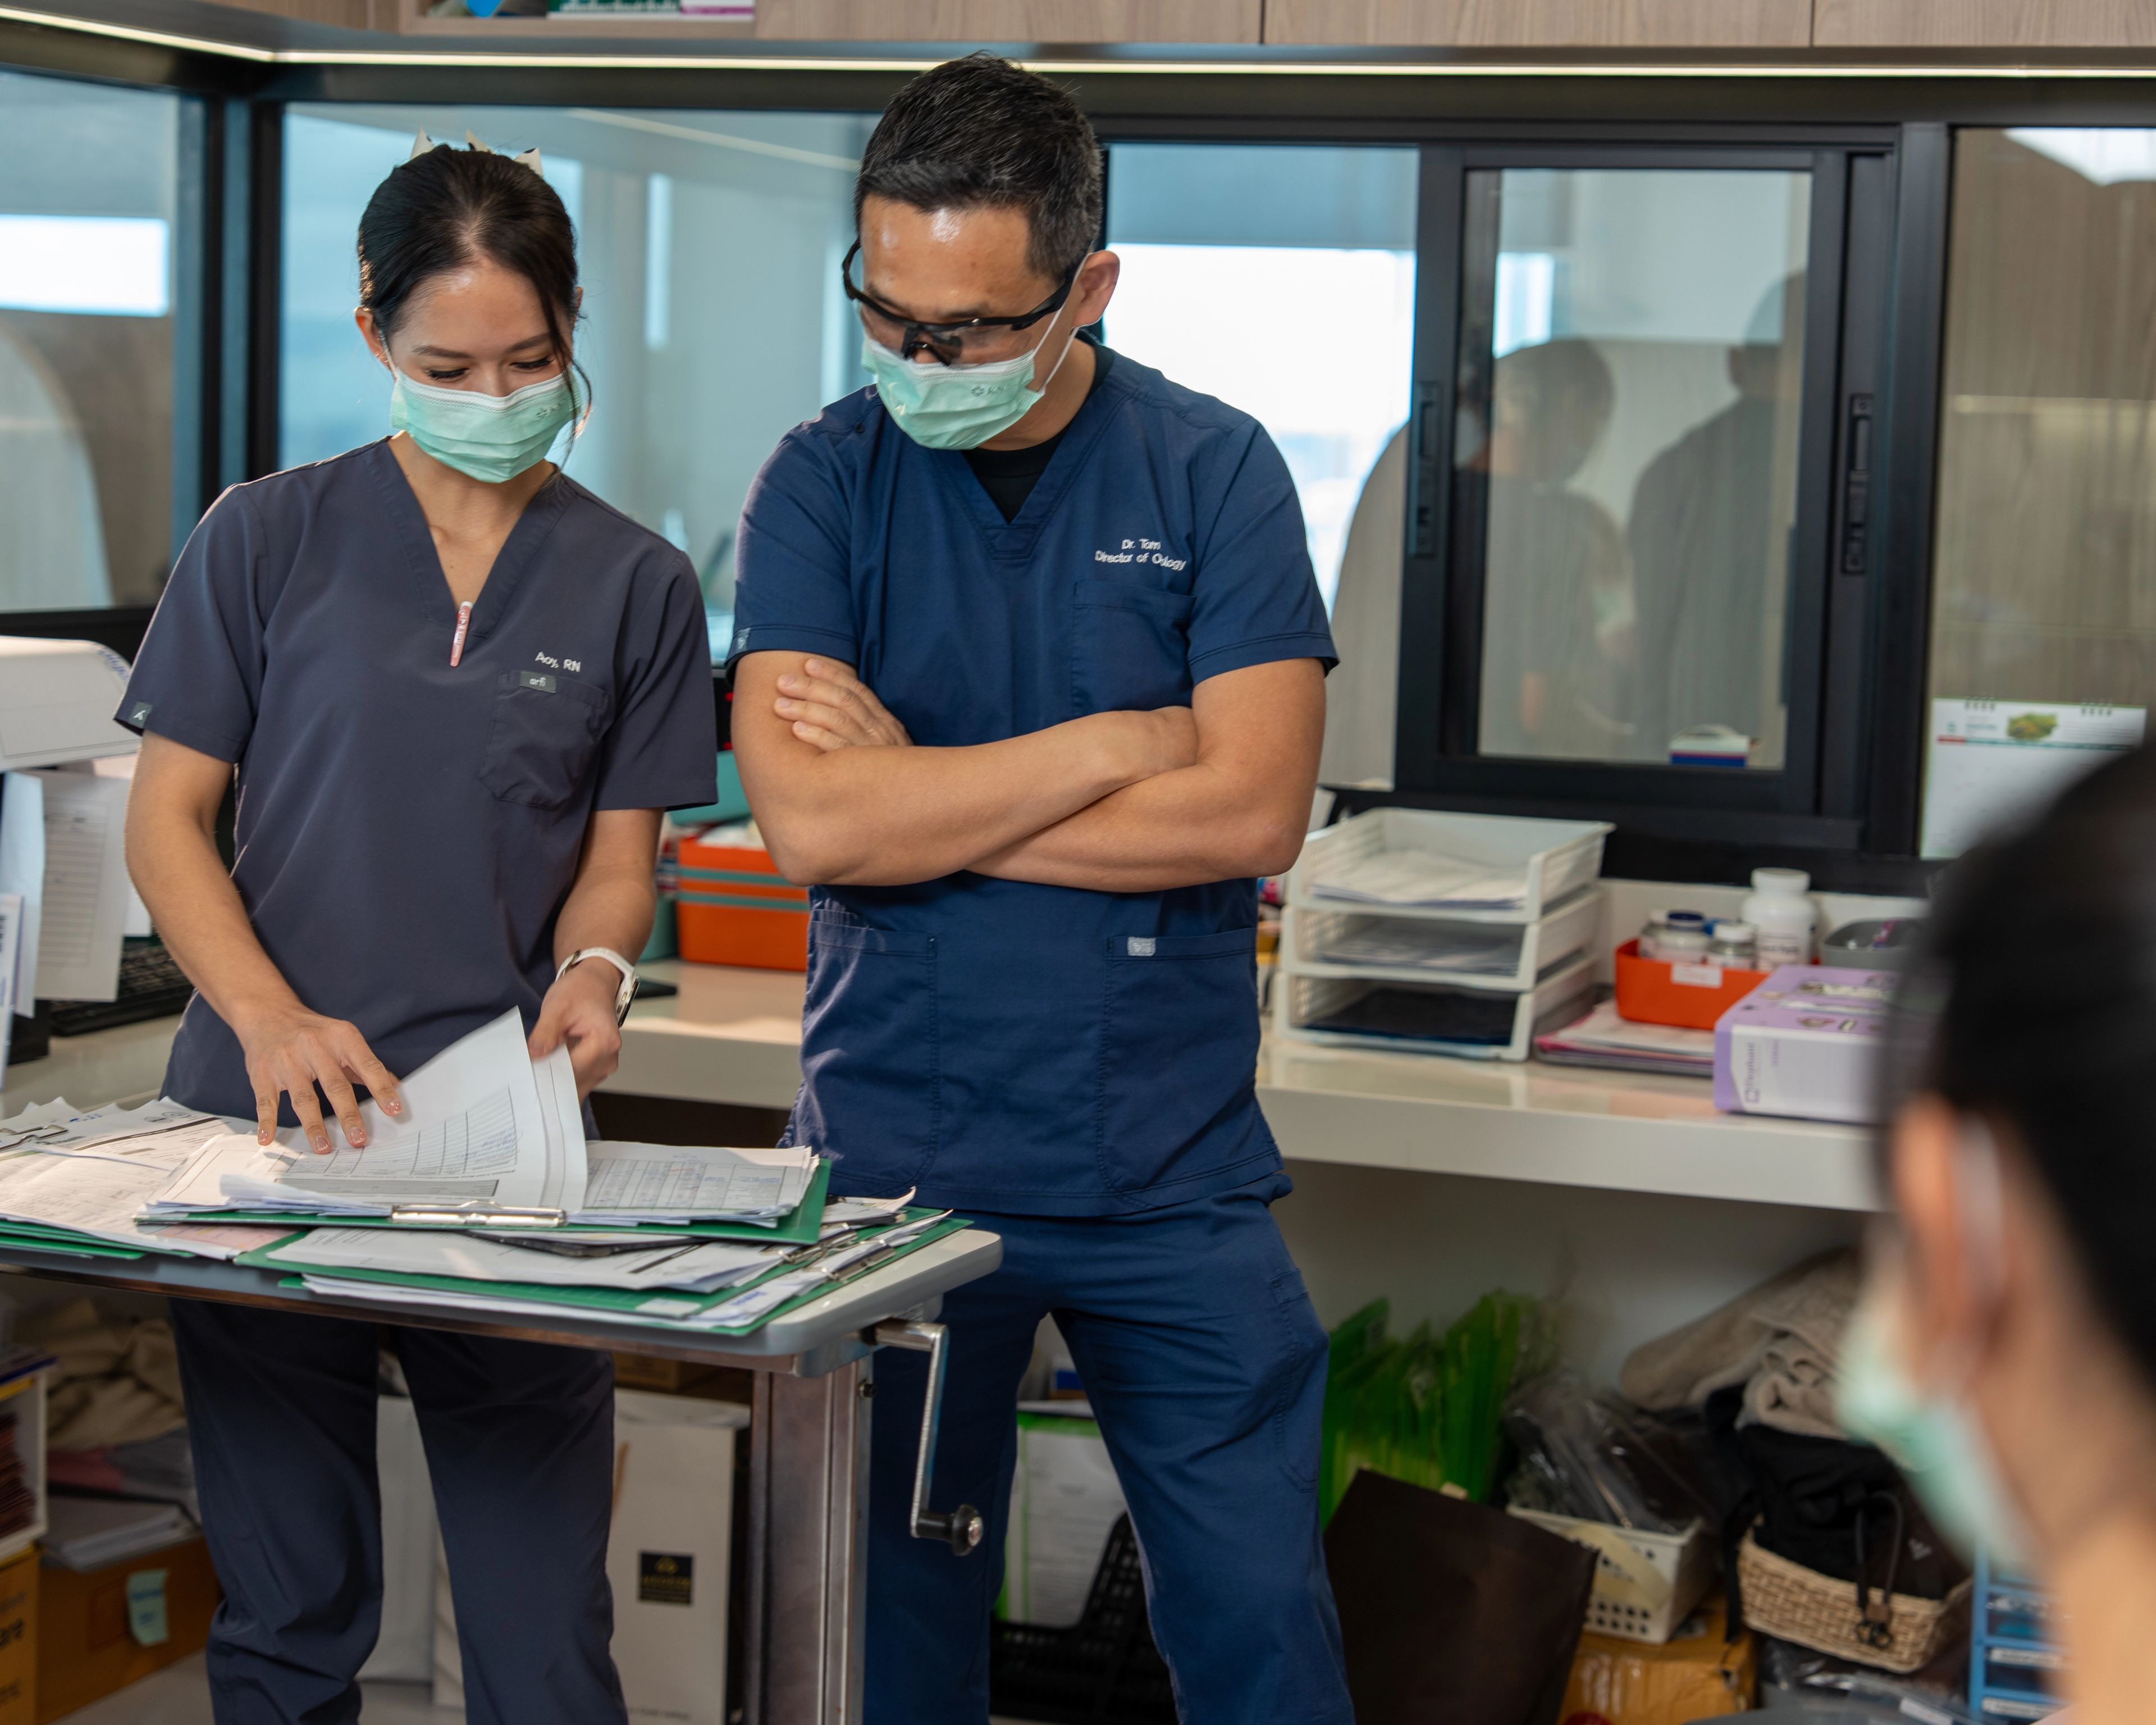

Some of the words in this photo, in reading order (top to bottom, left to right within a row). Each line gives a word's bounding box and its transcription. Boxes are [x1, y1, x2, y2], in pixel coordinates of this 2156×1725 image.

[1121, 539, 1135, 549] Dr.
[1139, 538, 1161, 550] Tom
[1094, 550, 1134, 563] Director
[1136, 552, 1150, 563] of
[563, 659, 582, 672] RN
